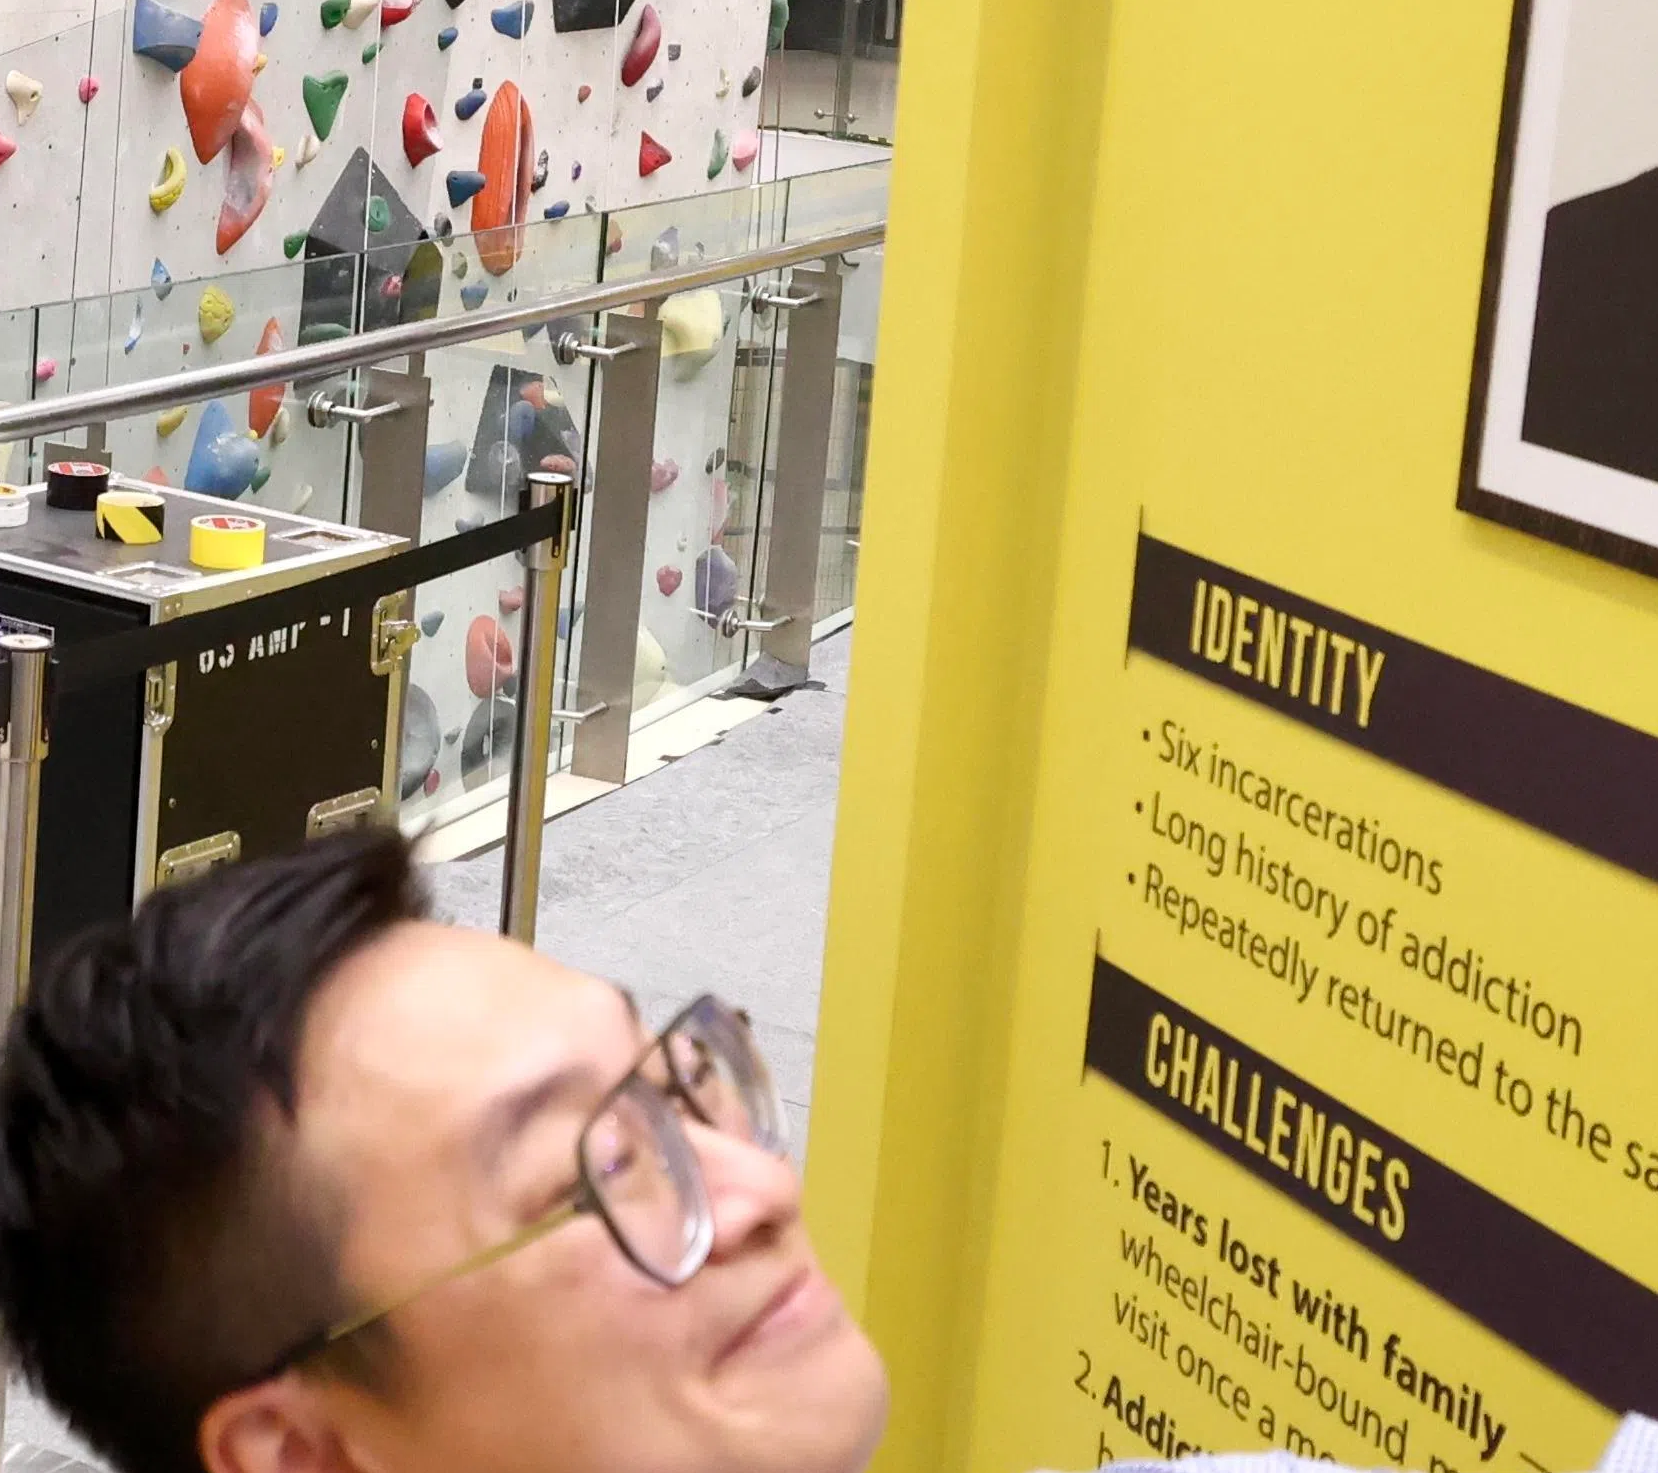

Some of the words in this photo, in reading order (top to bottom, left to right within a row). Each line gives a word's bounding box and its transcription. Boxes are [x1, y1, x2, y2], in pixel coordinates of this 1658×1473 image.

[1189, 578, 1384, 728] IDENTITY
[1153, 791, 1226, 876] Long
[1236, 832, 1348, 939] history
[1357, 907, 1397, 952] of
[1401, 935, 1582, 1057] addiction
[1159, 719, 1198, 777] Six
[1209, 743, 1444, 897] incarcerations
[1145, 862, 1319, 1004] Repeatedly
[1326, 975, 1484, 1090] returned
[1494, 1059, 1533, 1117] to
[1546, 1087, 1612, 1164] the
[1145, 1011, 1411, 1243] CHALLENGES
[1075, 1350, 1098, 1401] 2.
[1103, 1375, 1215, 1462] Addic
[1102, 1139, 1121, 1189] 1.
[1129, 1155, 1209, 1248] Years
[1220, 1219, 1281, 1300] lost
[1293, 1279, 1371, 1363] with
[1384, 1333, 1507, 1462] family
[1114, 1292, 1170, 1362] visit
[1178, 1351, 1252, 1423] once
[1259, 1403, 1276, 1443] a
[1120, 1229, 1409, 1466] wheelchair-bound
